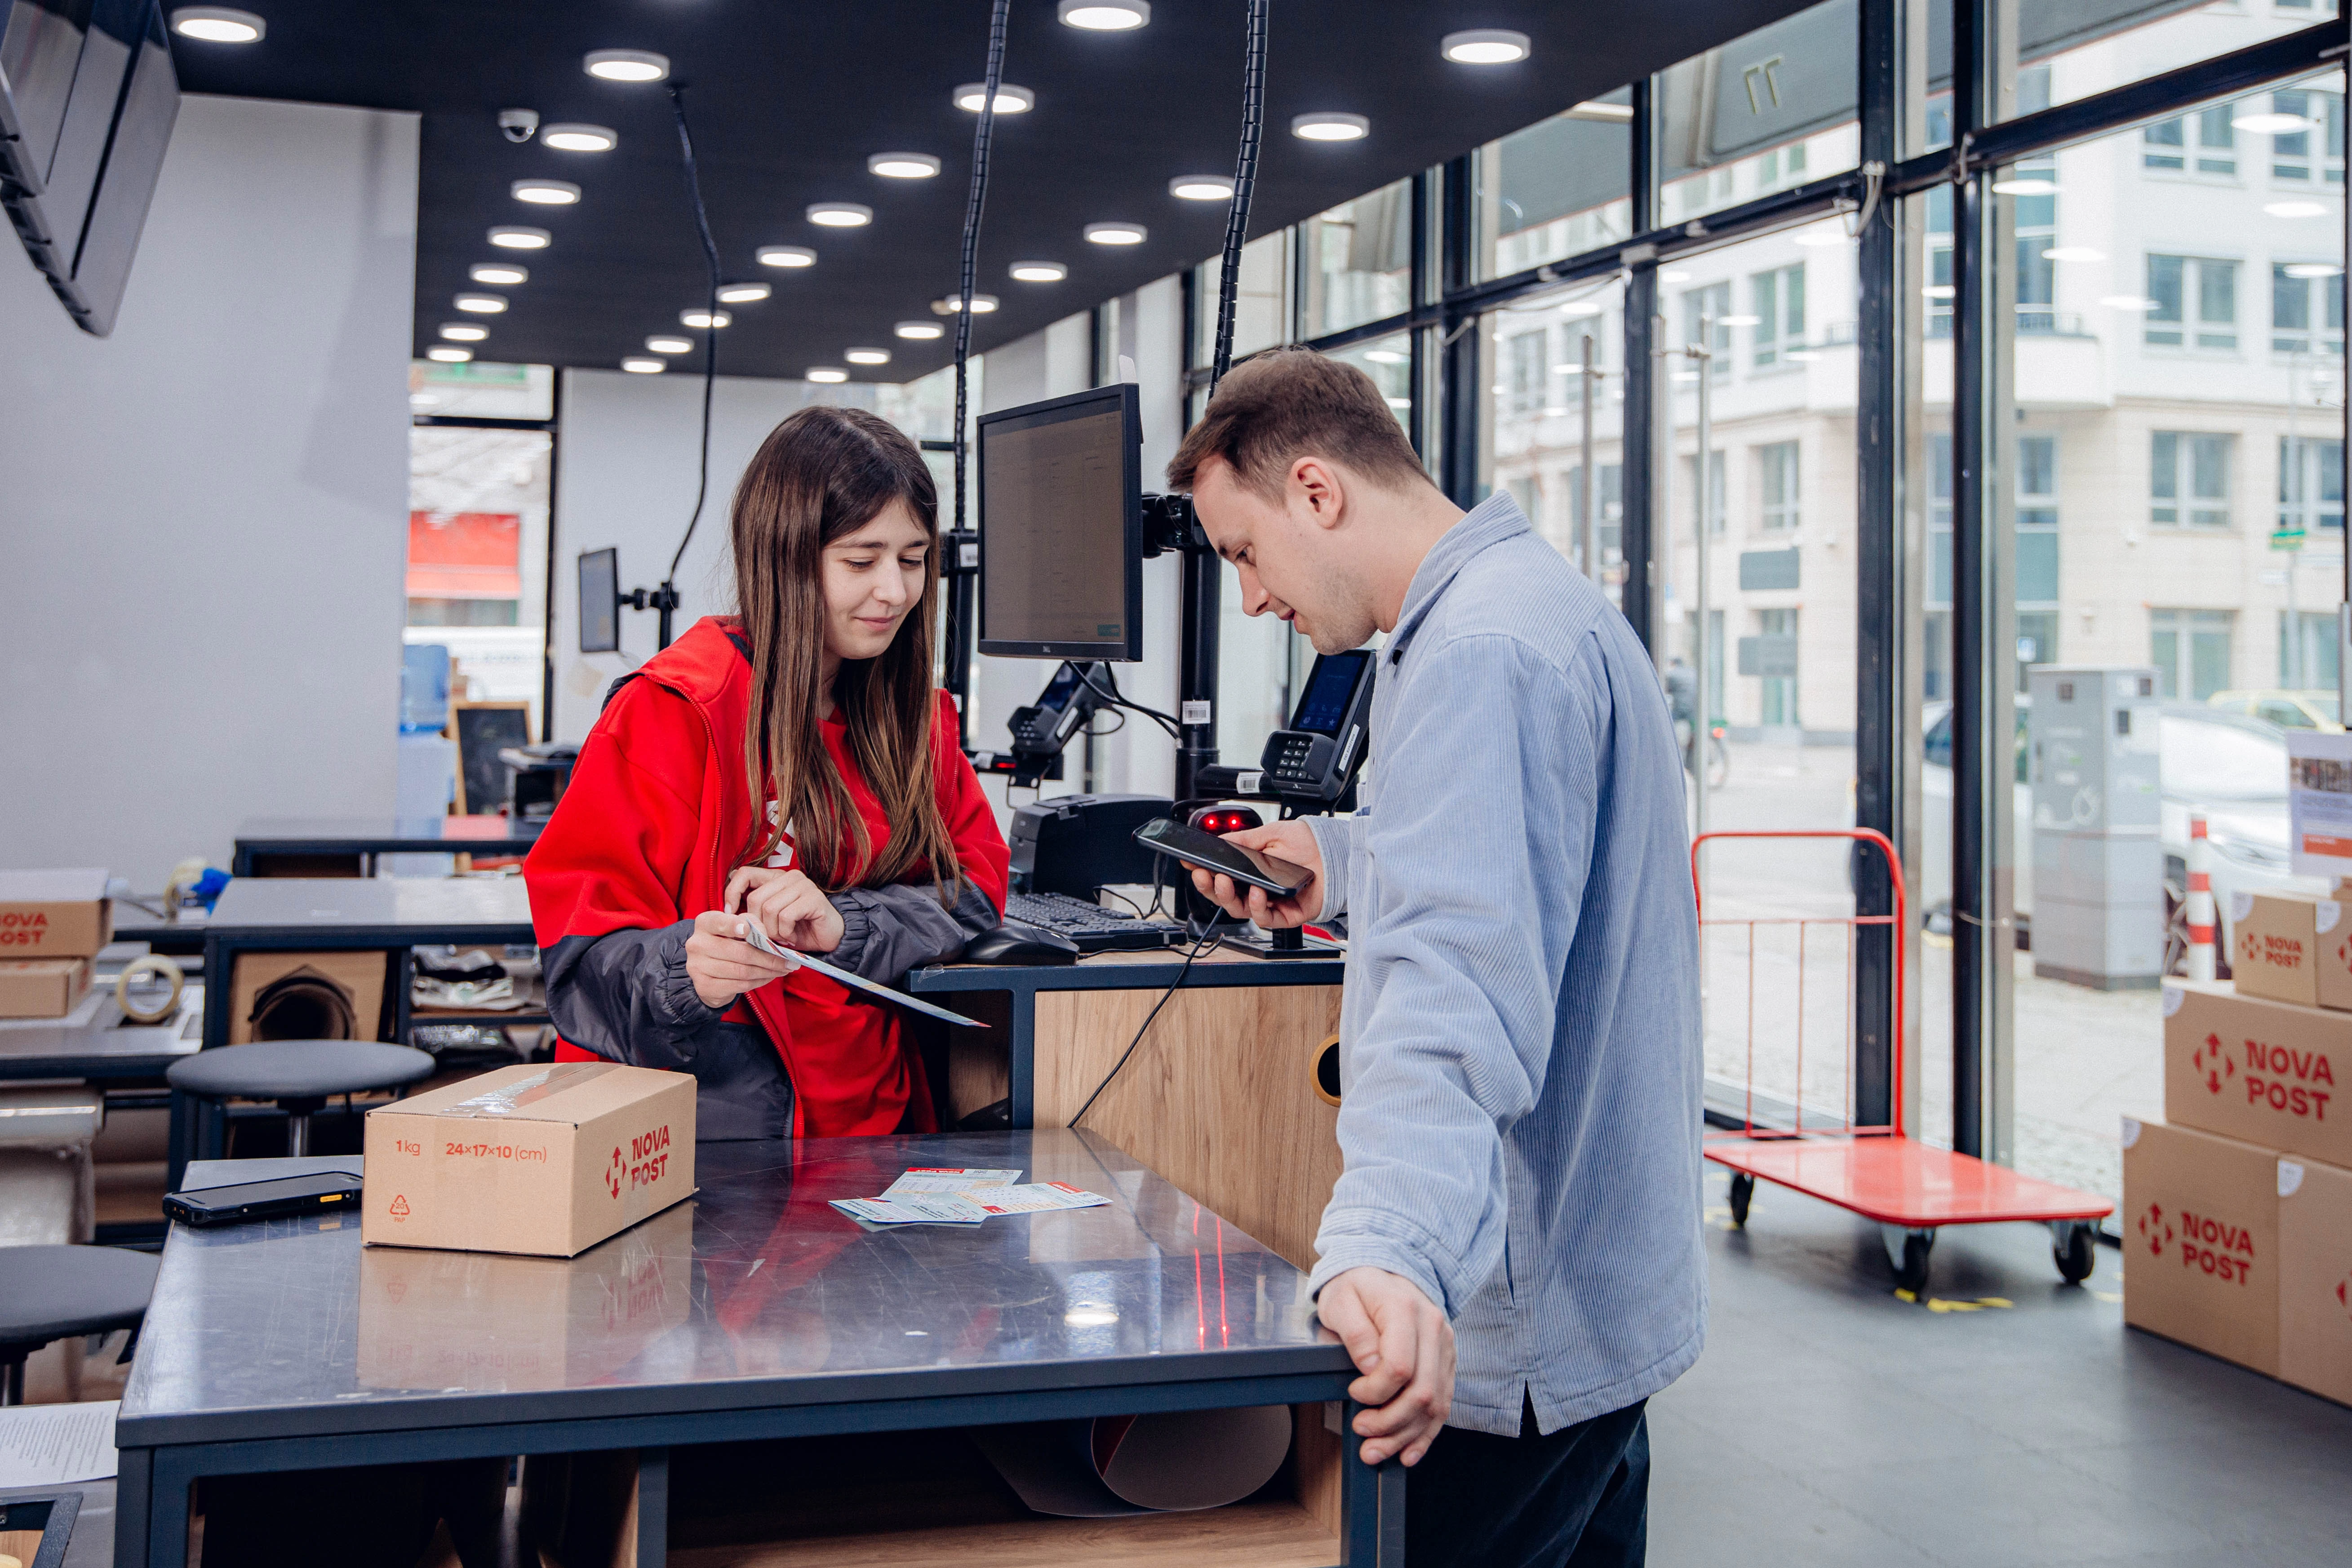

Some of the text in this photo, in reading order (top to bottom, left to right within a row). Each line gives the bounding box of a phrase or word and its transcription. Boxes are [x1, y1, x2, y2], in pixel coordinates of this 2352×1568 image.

[0, 913, 48, 927] OVA
[0, 931, 44, 945] OST
[2265, 935, 2303, 953] NOVA
[2265, 951, 2301, 968] POST
[2245, 1040, 2334, 1085] NOVA
[2246, 1076, 2331, 1120] POST
[631, 1125, 670, 1161] NOVA
[631, 1153, 668, 1191] POST
[2181, 1212, 2254, 1257] NOVA
[2182, 1243, 2251, 1285] POST
